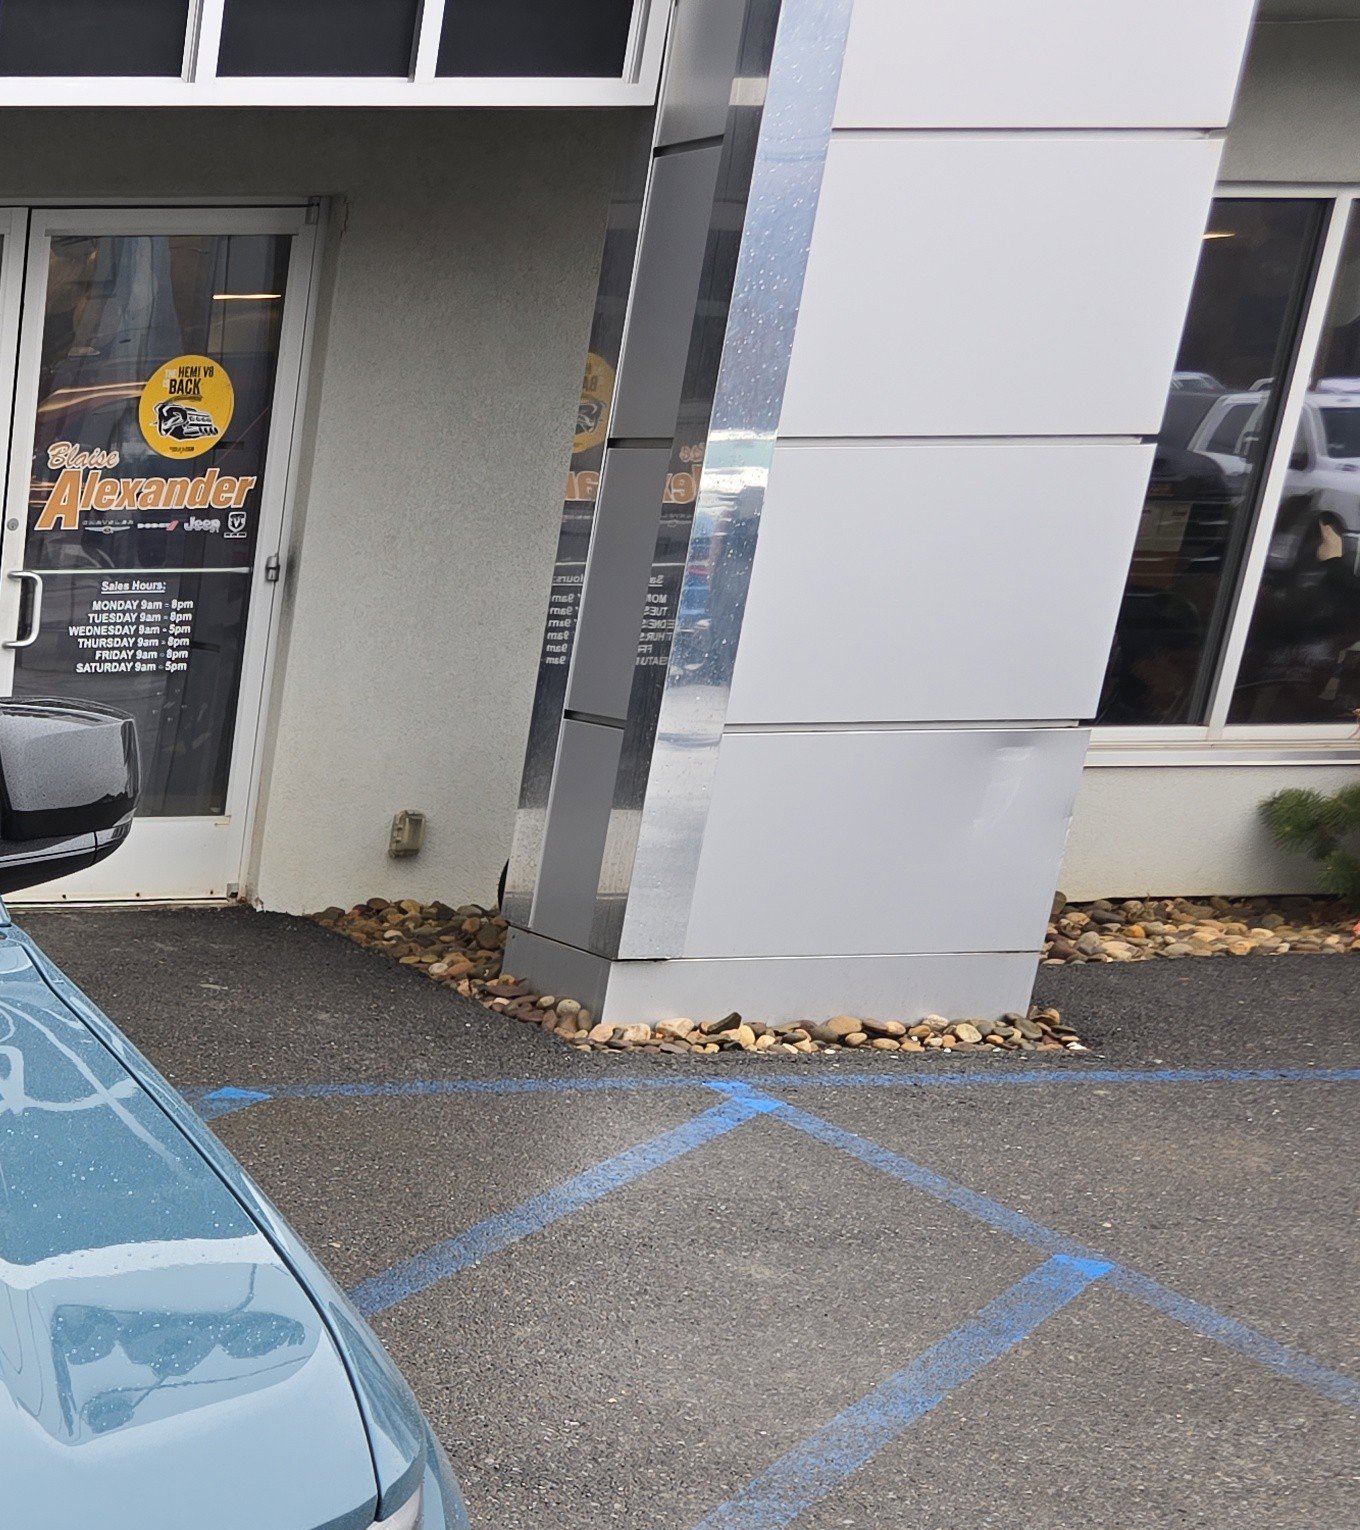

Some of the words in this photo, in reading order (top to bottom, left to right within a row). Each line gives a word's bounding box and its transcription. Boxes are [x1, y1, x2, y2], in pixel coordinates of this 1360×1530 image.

[178, 366, 201, 378] HEMI
[203, 366, 215, 378] V8
[169, 378, 201, 395] BACK
[47, 441, 119, 469] Blaise
[34, 468, 257, 531] Alexander
[183, 516, 221, 533] Jeep
[101, 581, 129, 591] Sales
[131, 580, 166, 591] Hours:
[92, 600, 139, 611] MONDAY
[140, 600, 162, 609] 9am
[88, 613, 138, 623] TUESDAY
[139, 612, 161, 622] 9am
[69, 625, 136, 636] WEDNESDAY
[138, 624, 160, 634] 9am
[77, 637, 135, 648] THURSDAY
[137, 637, 159, 647] 9am
[95, 650, 134, 660] FRIDAY
[135, 649, 157, 659] 9am
[76, 662, 133, 673] SATURDAY
[134, 661, 156, 672] 9am
